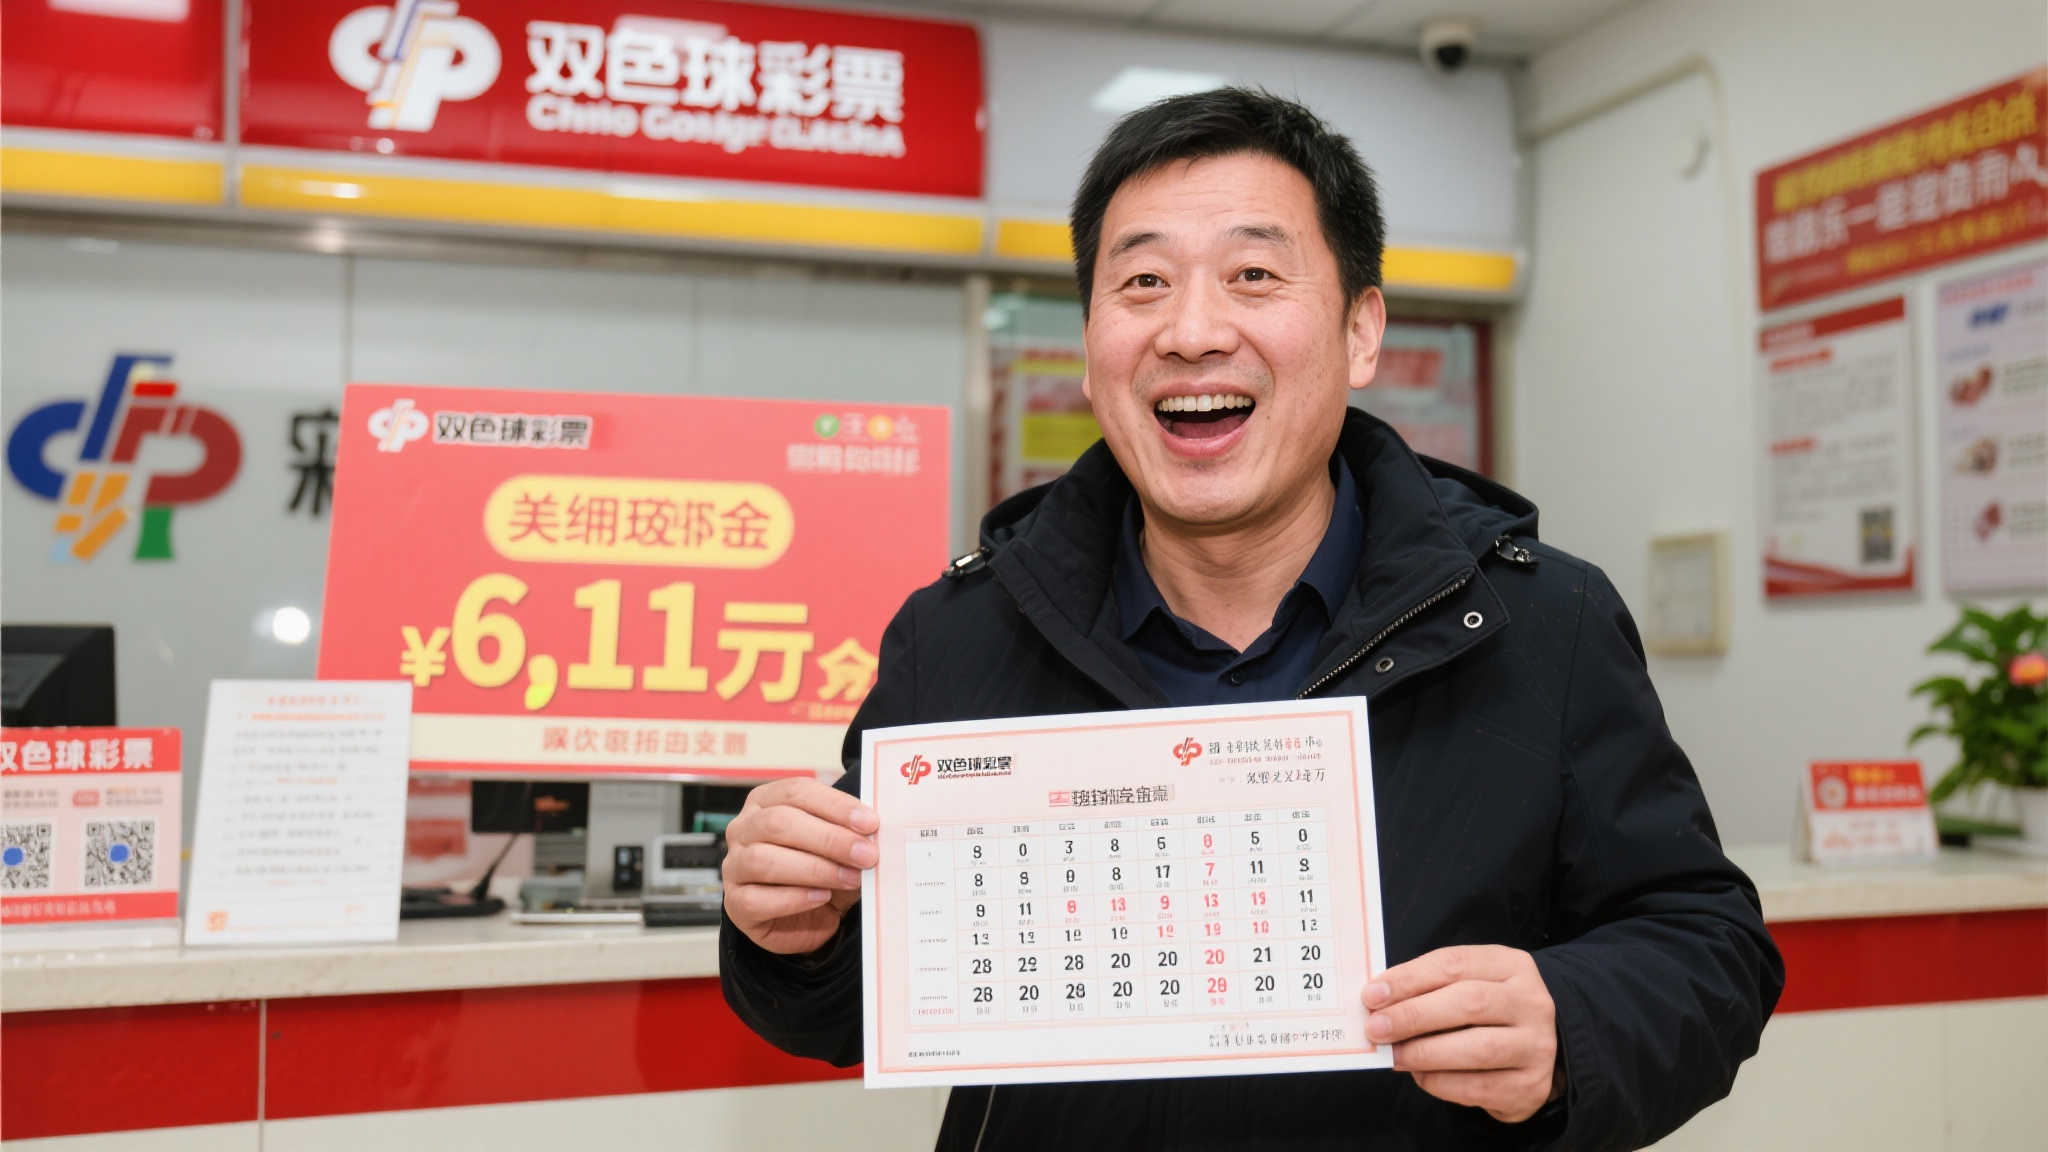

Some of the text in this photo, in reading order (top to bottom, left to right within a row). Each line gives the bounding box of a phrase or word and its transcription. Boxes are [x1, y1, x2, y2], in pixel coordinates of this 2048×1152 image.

[525, 20, 905, 124] 双色球彩票
[436, 413, 591, 447] 双色球彩票
[1018, 843, 1028, 857] 0
[1065, 840, 1073, 854] 3
[1110, 838, 1120, 853] 8
[1250, 831, 1260, 845] 5
[974, 873, 984, 887] 8
[1112, 866, 1122, 882] 8
[1155, 864, 1171, 879] 17
[1204, 862, 1216, 877] 7
[1250, 860, 1263, 874] 11
[1019, 902, 1032, 916] 11
[1111, 897, 1127, 912] 13
[1160, 895, 1170, 910] 9
[1299, 888, 1313, 904] 11
[1064, 954, 1084, 971] 28
[1110, 952, 1131, 969] 20
[1157, 951, 1178, 967] 20
[1204, 948, 1225, 965] 20
[1252, 946, 1272, 963] 21
[1301, 944, 1321, 961] 20
[1019, 984, 1039, 1001] 20
[1112, 980, 1133, 998] 20
[1159, 979, 1180, 996] 20
[1254, 975, 1275, 992] 20
[1302, 972, 1324, 990] 20
